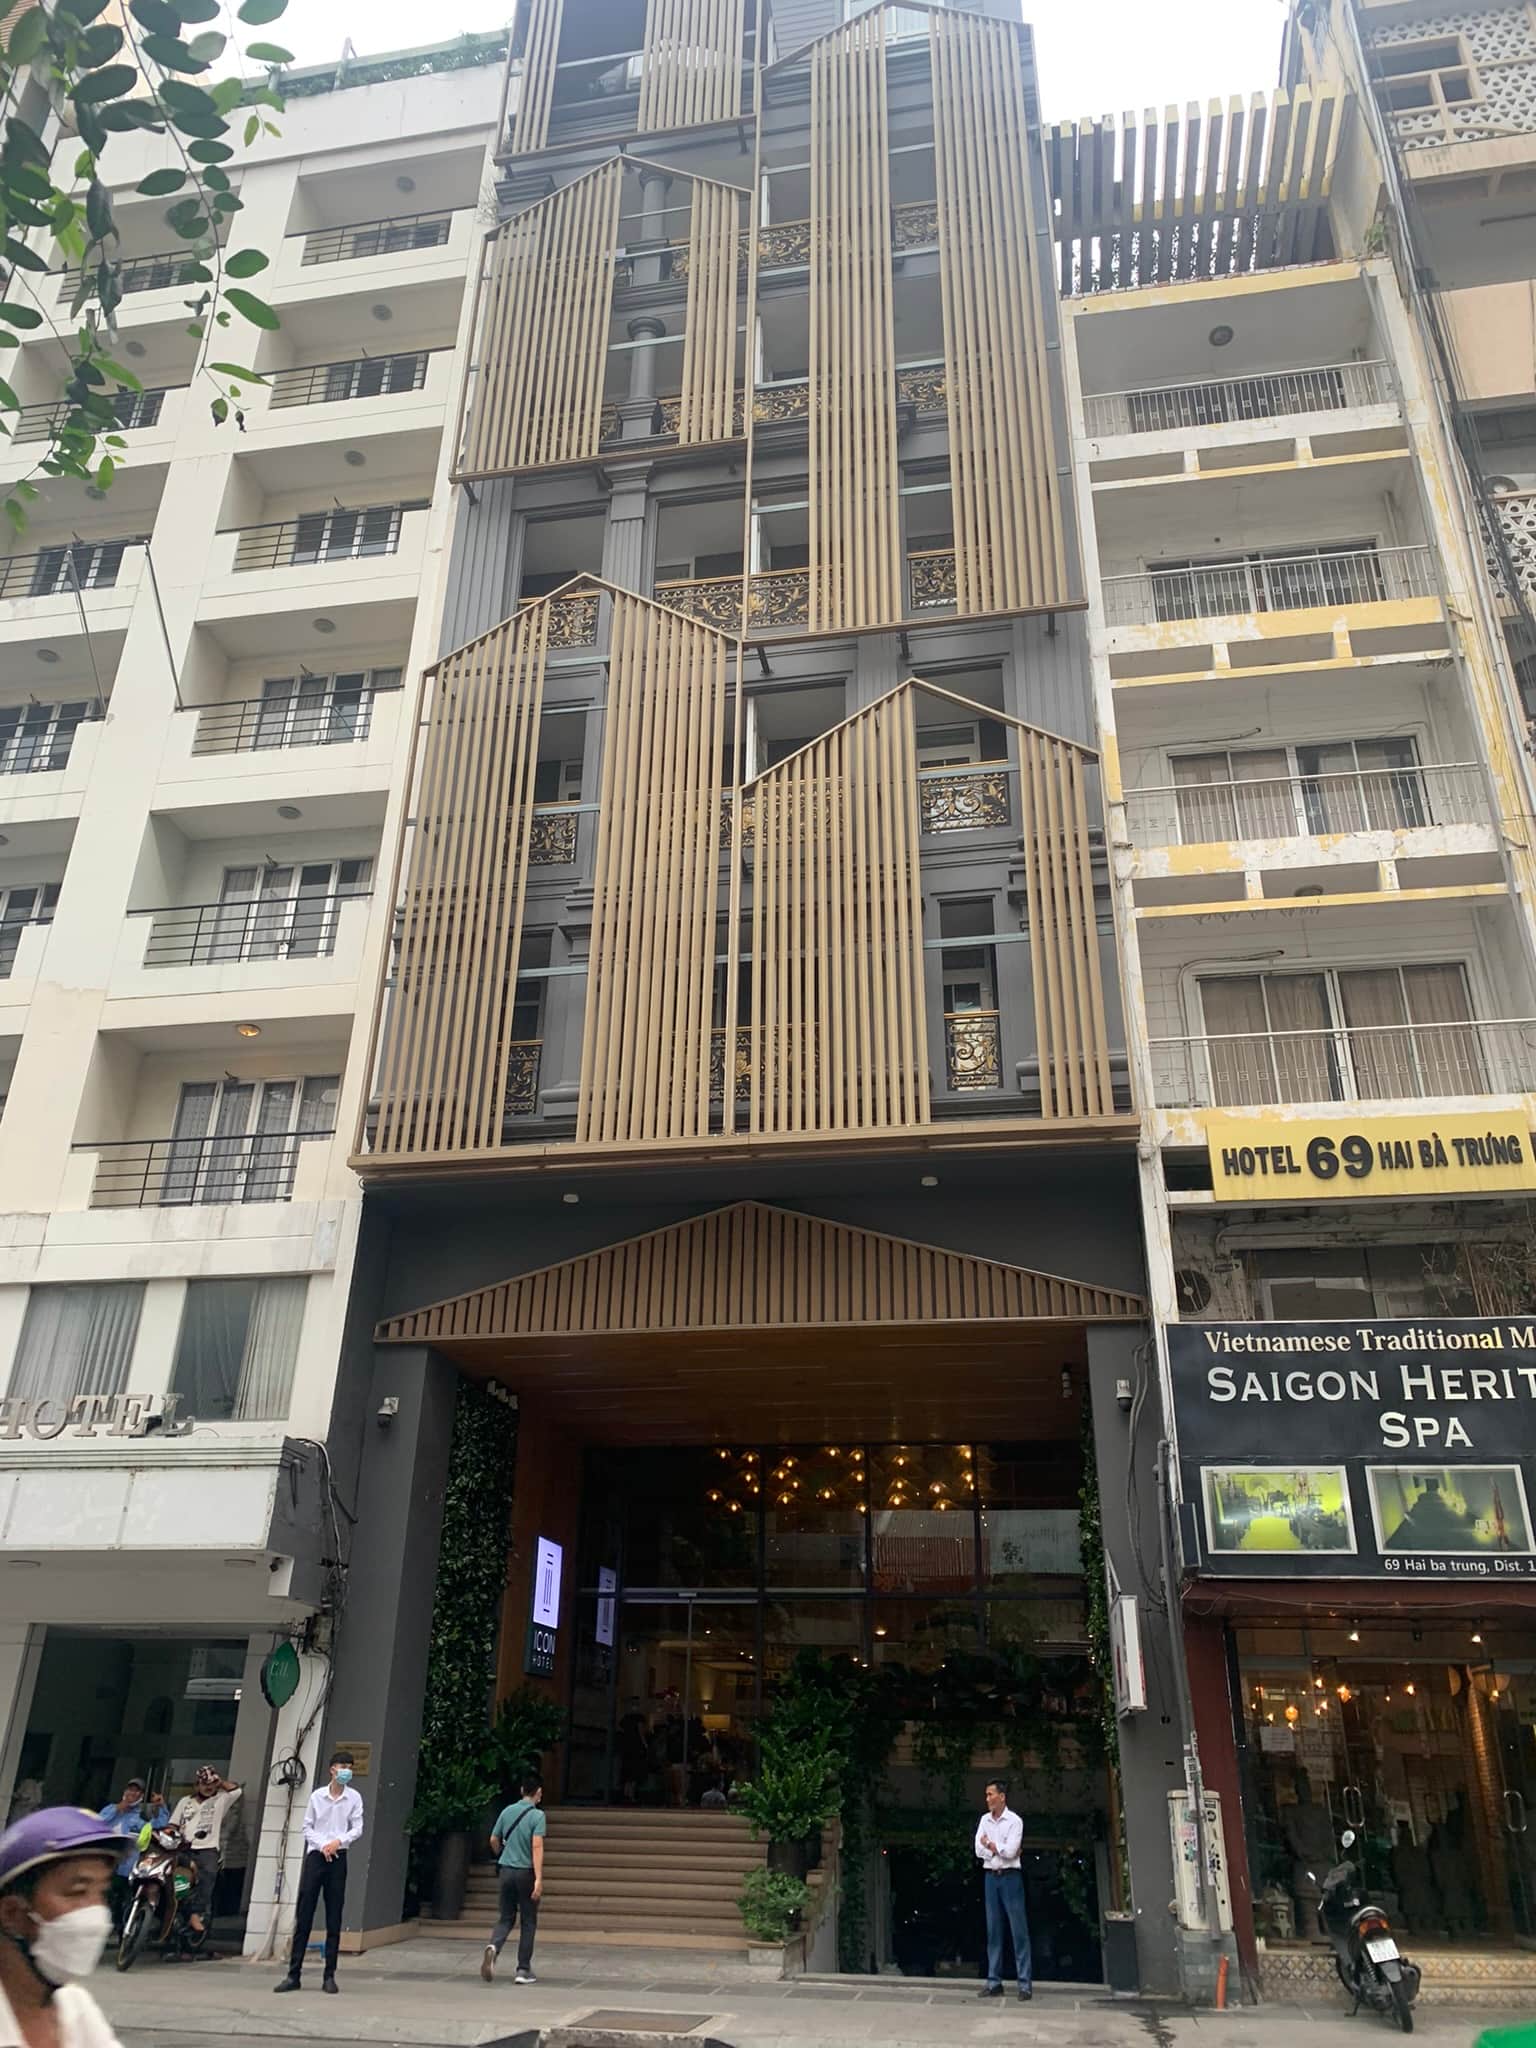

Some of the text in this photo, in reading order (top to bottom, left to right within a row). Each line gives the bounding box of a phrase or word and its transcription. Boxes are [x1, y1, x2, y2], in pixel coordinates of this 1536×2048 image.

[1221, 1145, 1301, 1176] HOTEL
[1307, 1135, 1373, 1179] 69
[1377, 1140, 1414, 1169] HAI
[1417, 1132, 1448, 1168] BÀ
[1204, 1331, 1351, 1353] Vietnamese
[1356, 1326, 1504, 1351] Traditional
[1207, 1366, 1380, 1402] SAIGON
[1379, 1411, 1474, 1448] SPA
[1384, 1558, 1400, 1571] 69
[1404, 1558, 1426, 1571] Hai
[1430, 1559, 1446, 1571] ba
[1450, 1560, 1490, 1575] trung,
[1494, 1559, 1524, 1573] Dist.
[533, 1630, 556, 1655] ICON
